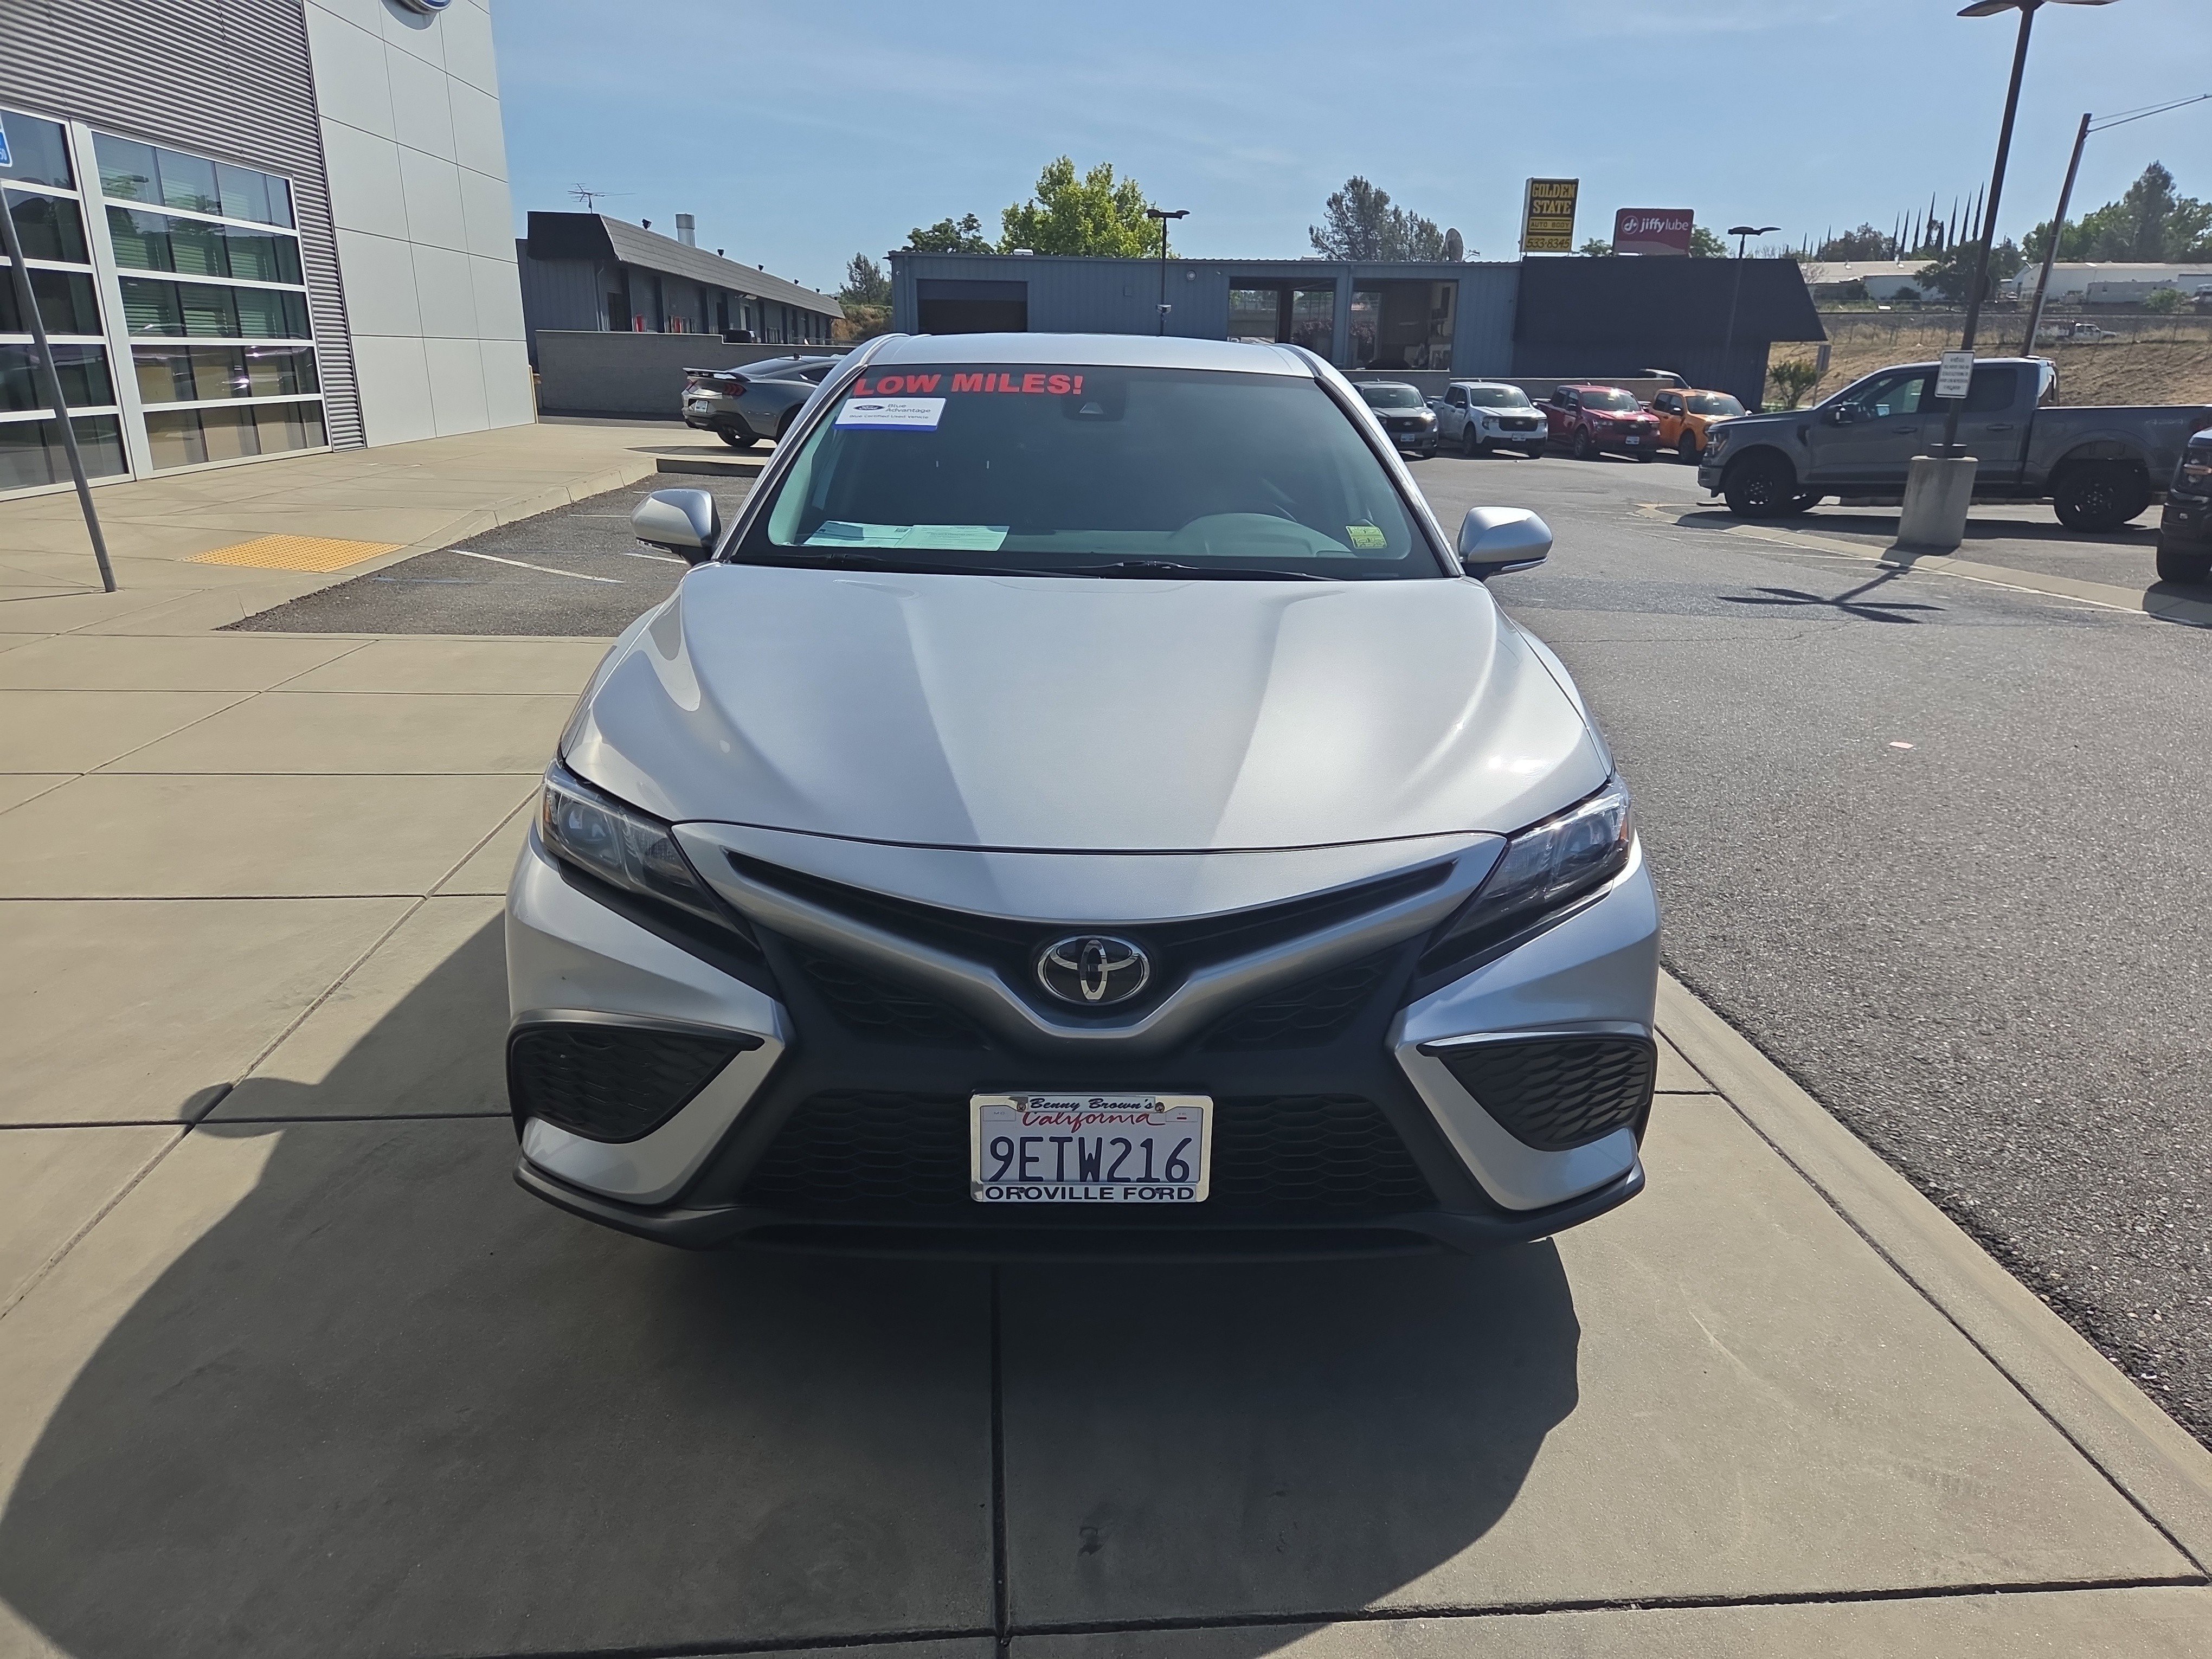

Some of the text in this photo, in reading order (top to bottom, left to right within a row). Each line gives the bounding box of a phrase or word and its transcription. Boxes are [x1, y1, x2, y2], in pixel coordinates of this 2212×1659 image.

[1532, 184, 1577, 198] GOLDEN
[1533, 200, 1572, 214] STATE
[854, 373, 1083, 396] LOW MILES!
[1029, 1098, 1153, 1111] Benny Brown's
[1022, 1111, 1166, 1133] California
[989, 1136, 1192, 1182] 9ETW216
[985, 1186, 1194, 1200] OROVILLE FORD
